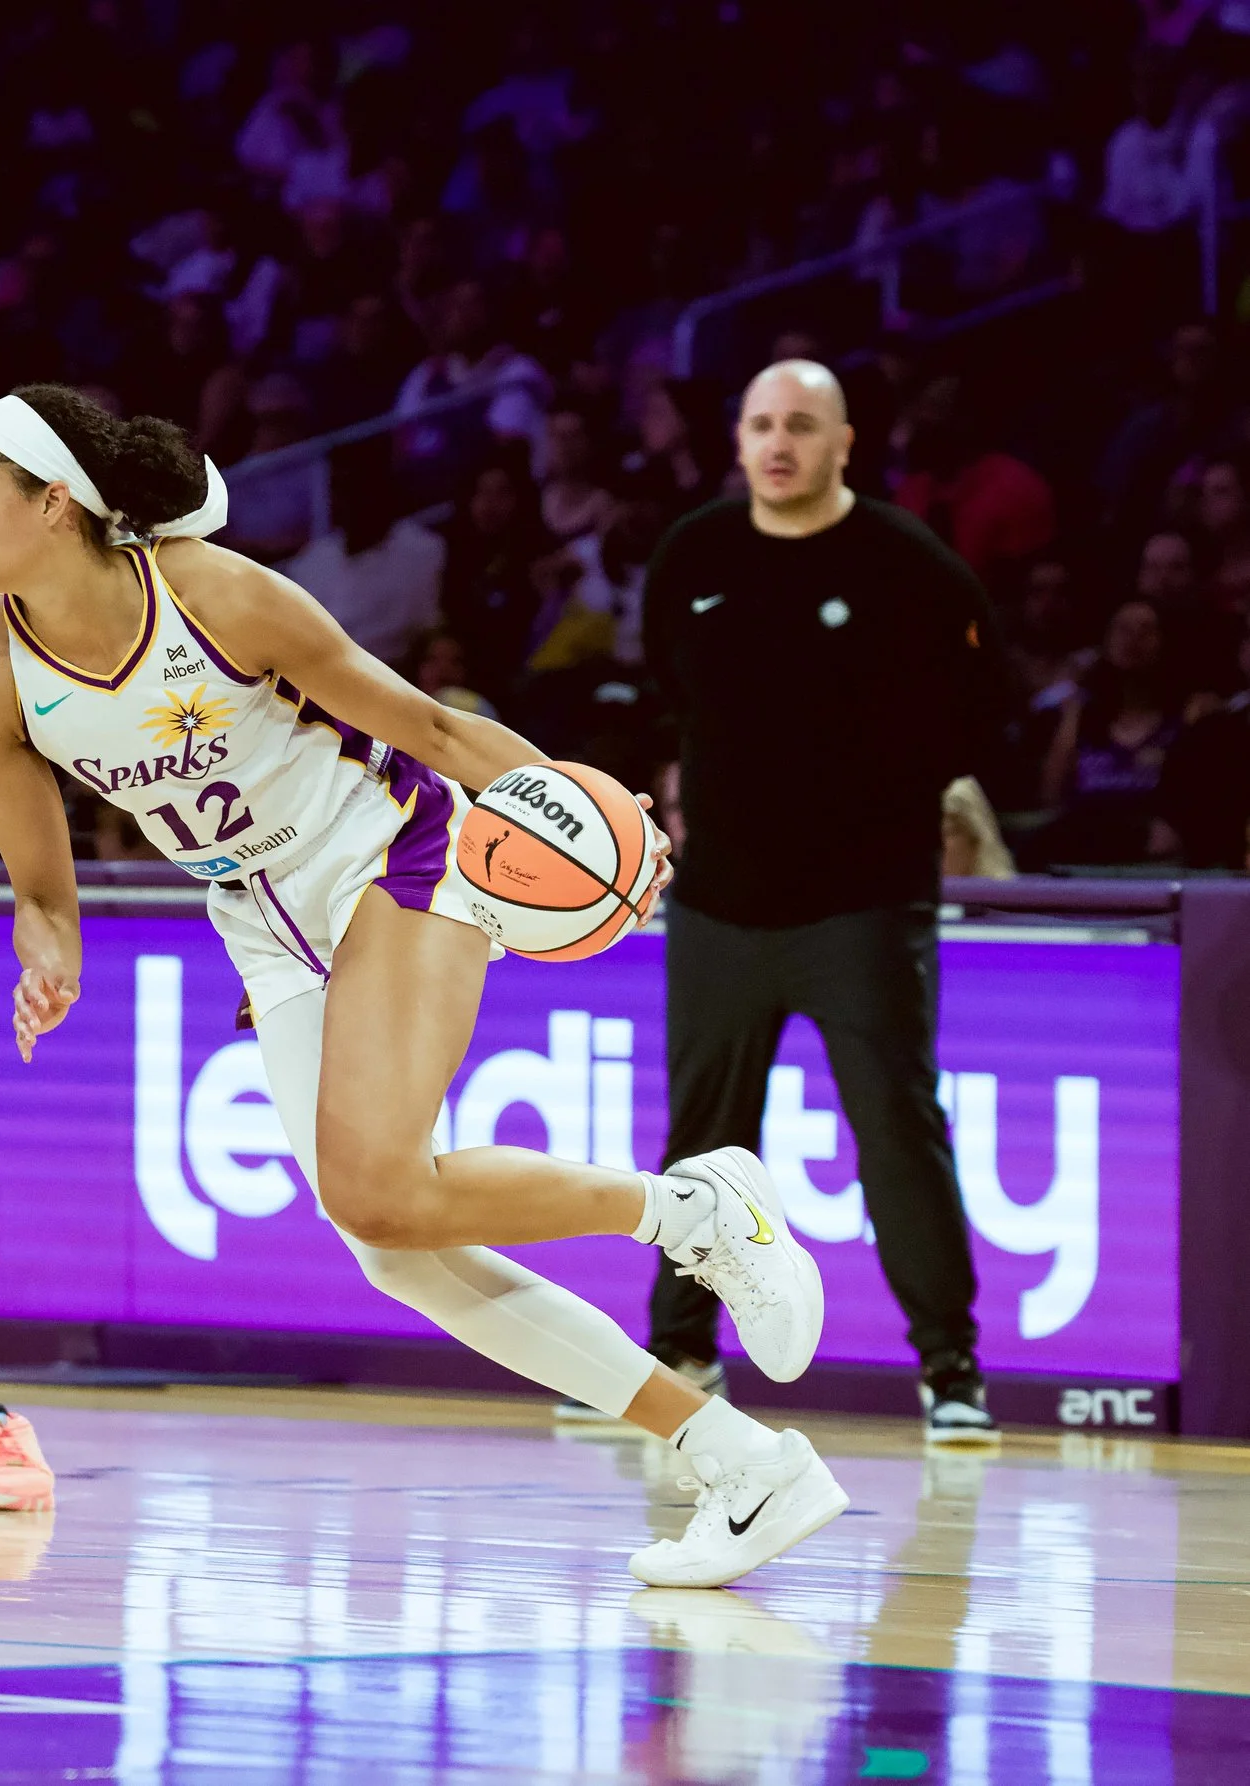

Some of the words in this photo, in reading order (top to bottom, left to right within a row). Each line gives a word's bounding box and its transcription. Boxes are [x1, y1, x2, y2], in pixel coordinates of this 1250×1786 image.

[164, 658, 207, 682] Albert
[146, 781, 254, 852] 12
[489, 772, 583, 842] Wilson
[182, 861, 230, 875] UCLA
[232, 825, 298, 861] Health
[134, 955, 1100, 1341] ledity
[1059, 1388, 1156, 1426] anc
